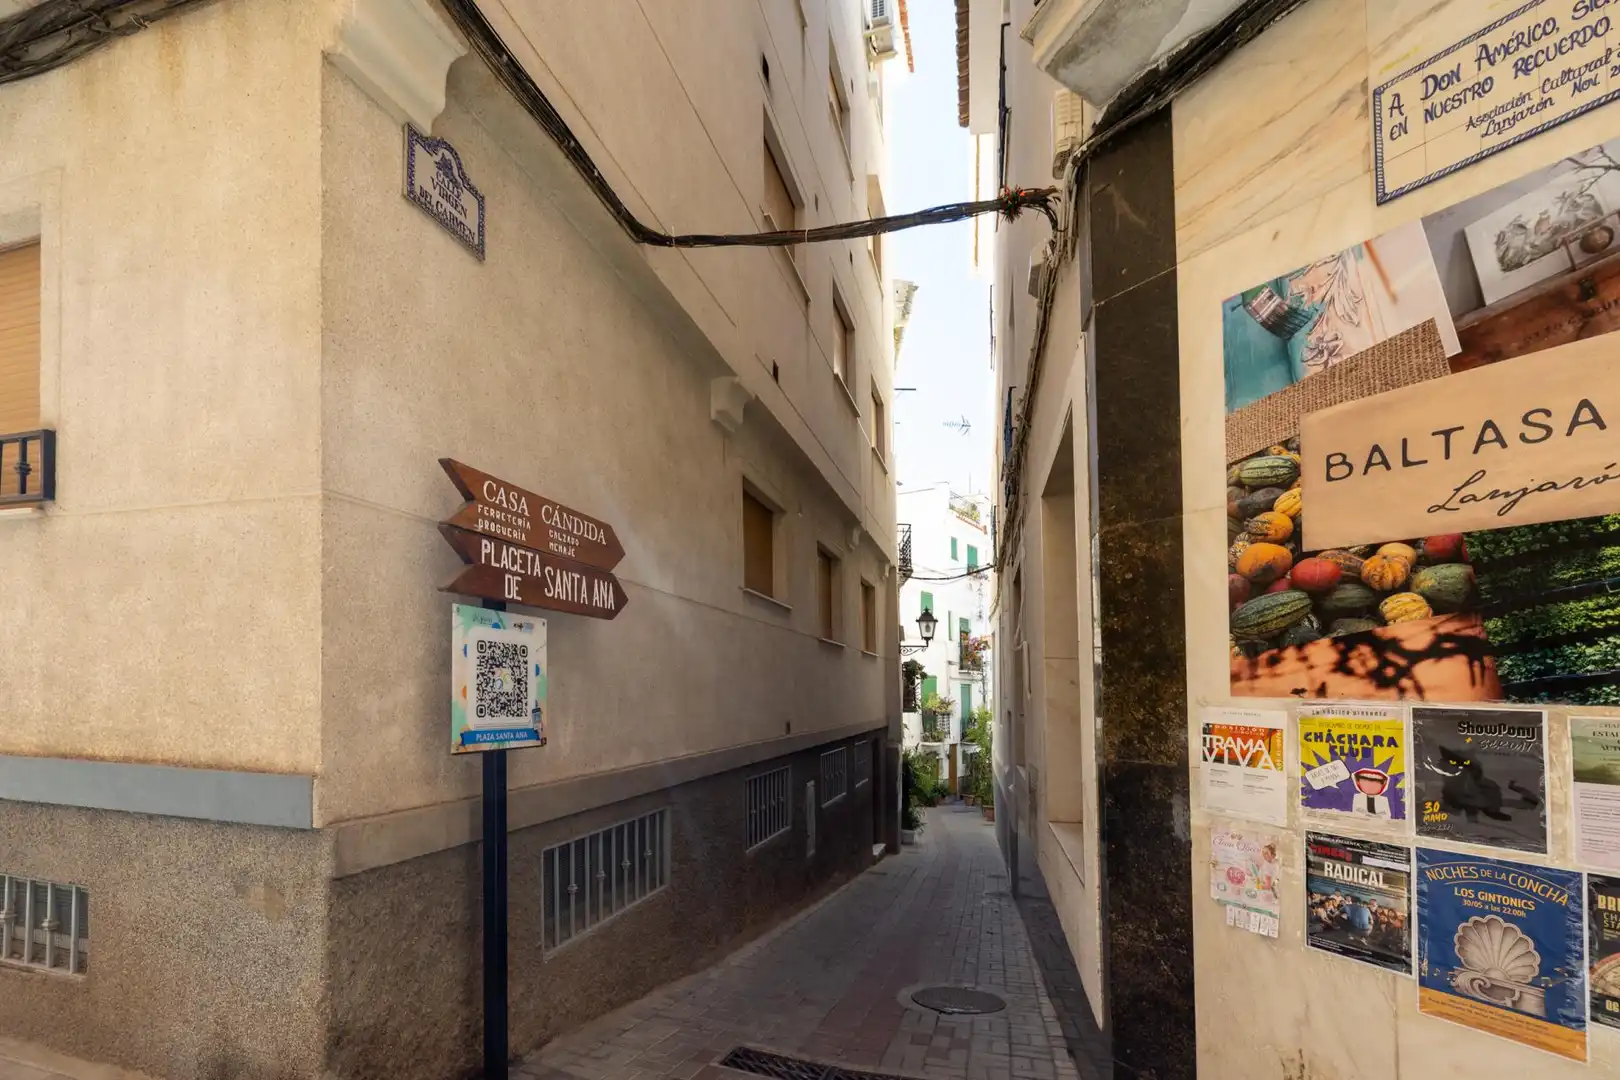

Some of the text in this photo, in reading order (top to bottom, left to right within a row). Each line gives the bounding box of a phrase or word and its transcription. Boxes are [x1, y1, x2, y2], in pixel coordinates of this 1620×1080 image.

[1389, 16, 1613, 141] EN NUESTRO RECUERDO.
[1466, 47, 1613, 132] Asociación Cultural
[1388, 93, 1405, 118] A
[1481, 96, 1555, 138] Lanjarón
[430, 176, 468, 219] VIRGEN
[436, 170, 463, 201] CALLE
[420, 185, 475, 242] DEL CARMEN
[1325, 398, 1607, 482] BALTASA
[478, 504, 531, 530] FERRETERÍA
[483, 480, 607, 545] CASA CÁNDIDA
[478, 518, 526, 541] DROGUERÍA
[548, 529, 580, 546] CALZADO
[481, 539, 541, 578] PLACETA
[549, 541, 576, 557] MENAJE
[504, 574, 522, 601] DE
[544, 566, 615, 610] SANTA ANA
[476, 733, 495, 741] PLAZA
[496, 732, 514, 740] SANTA
[1304, 729, 1399, 748] CHÁCHARA
[1458, 720, 1537, 741] ShowPony
[1202, 734, 1270, 754] TRAMA
[1329, 745, 1371, 758] CLUB
[1202, 747, 1278, 773] VIVA
[1423, 800, 1440, 814] 30
[1423, 812, 1449, 822] MAYO
[1323, 861, 1389, 889] RADICAL
[1425, 866, 1570, 906] NOCHES DE LA CONCHA
[1454, 886, 1536, 911] LOS GINTONICS
[1463, 899, 1483, 909] 30/05
